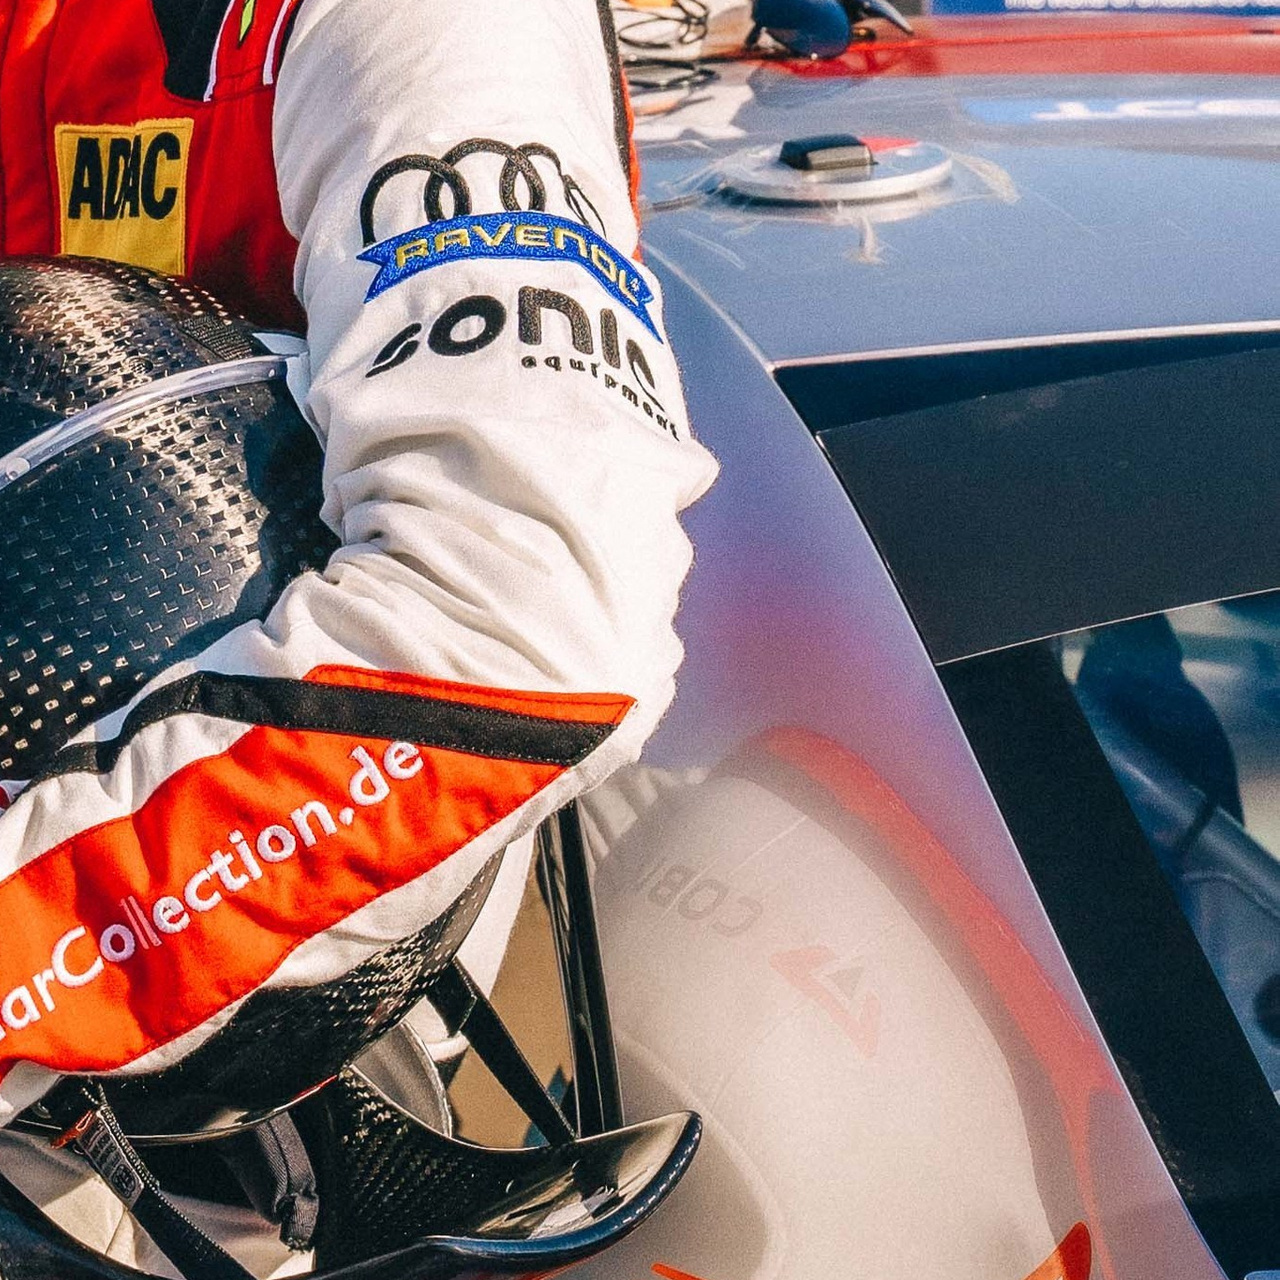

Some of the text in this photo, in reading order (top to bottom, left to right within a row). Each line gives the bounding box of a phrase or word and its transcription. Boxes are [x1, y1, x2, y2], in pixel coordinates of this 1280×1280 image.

[67, 132, 181, 221] ADAC
[394, 222, 641, 306] RAVENOL
[365, 285, 666, 413] sonic
[521, 355, 681, 442] equipment
